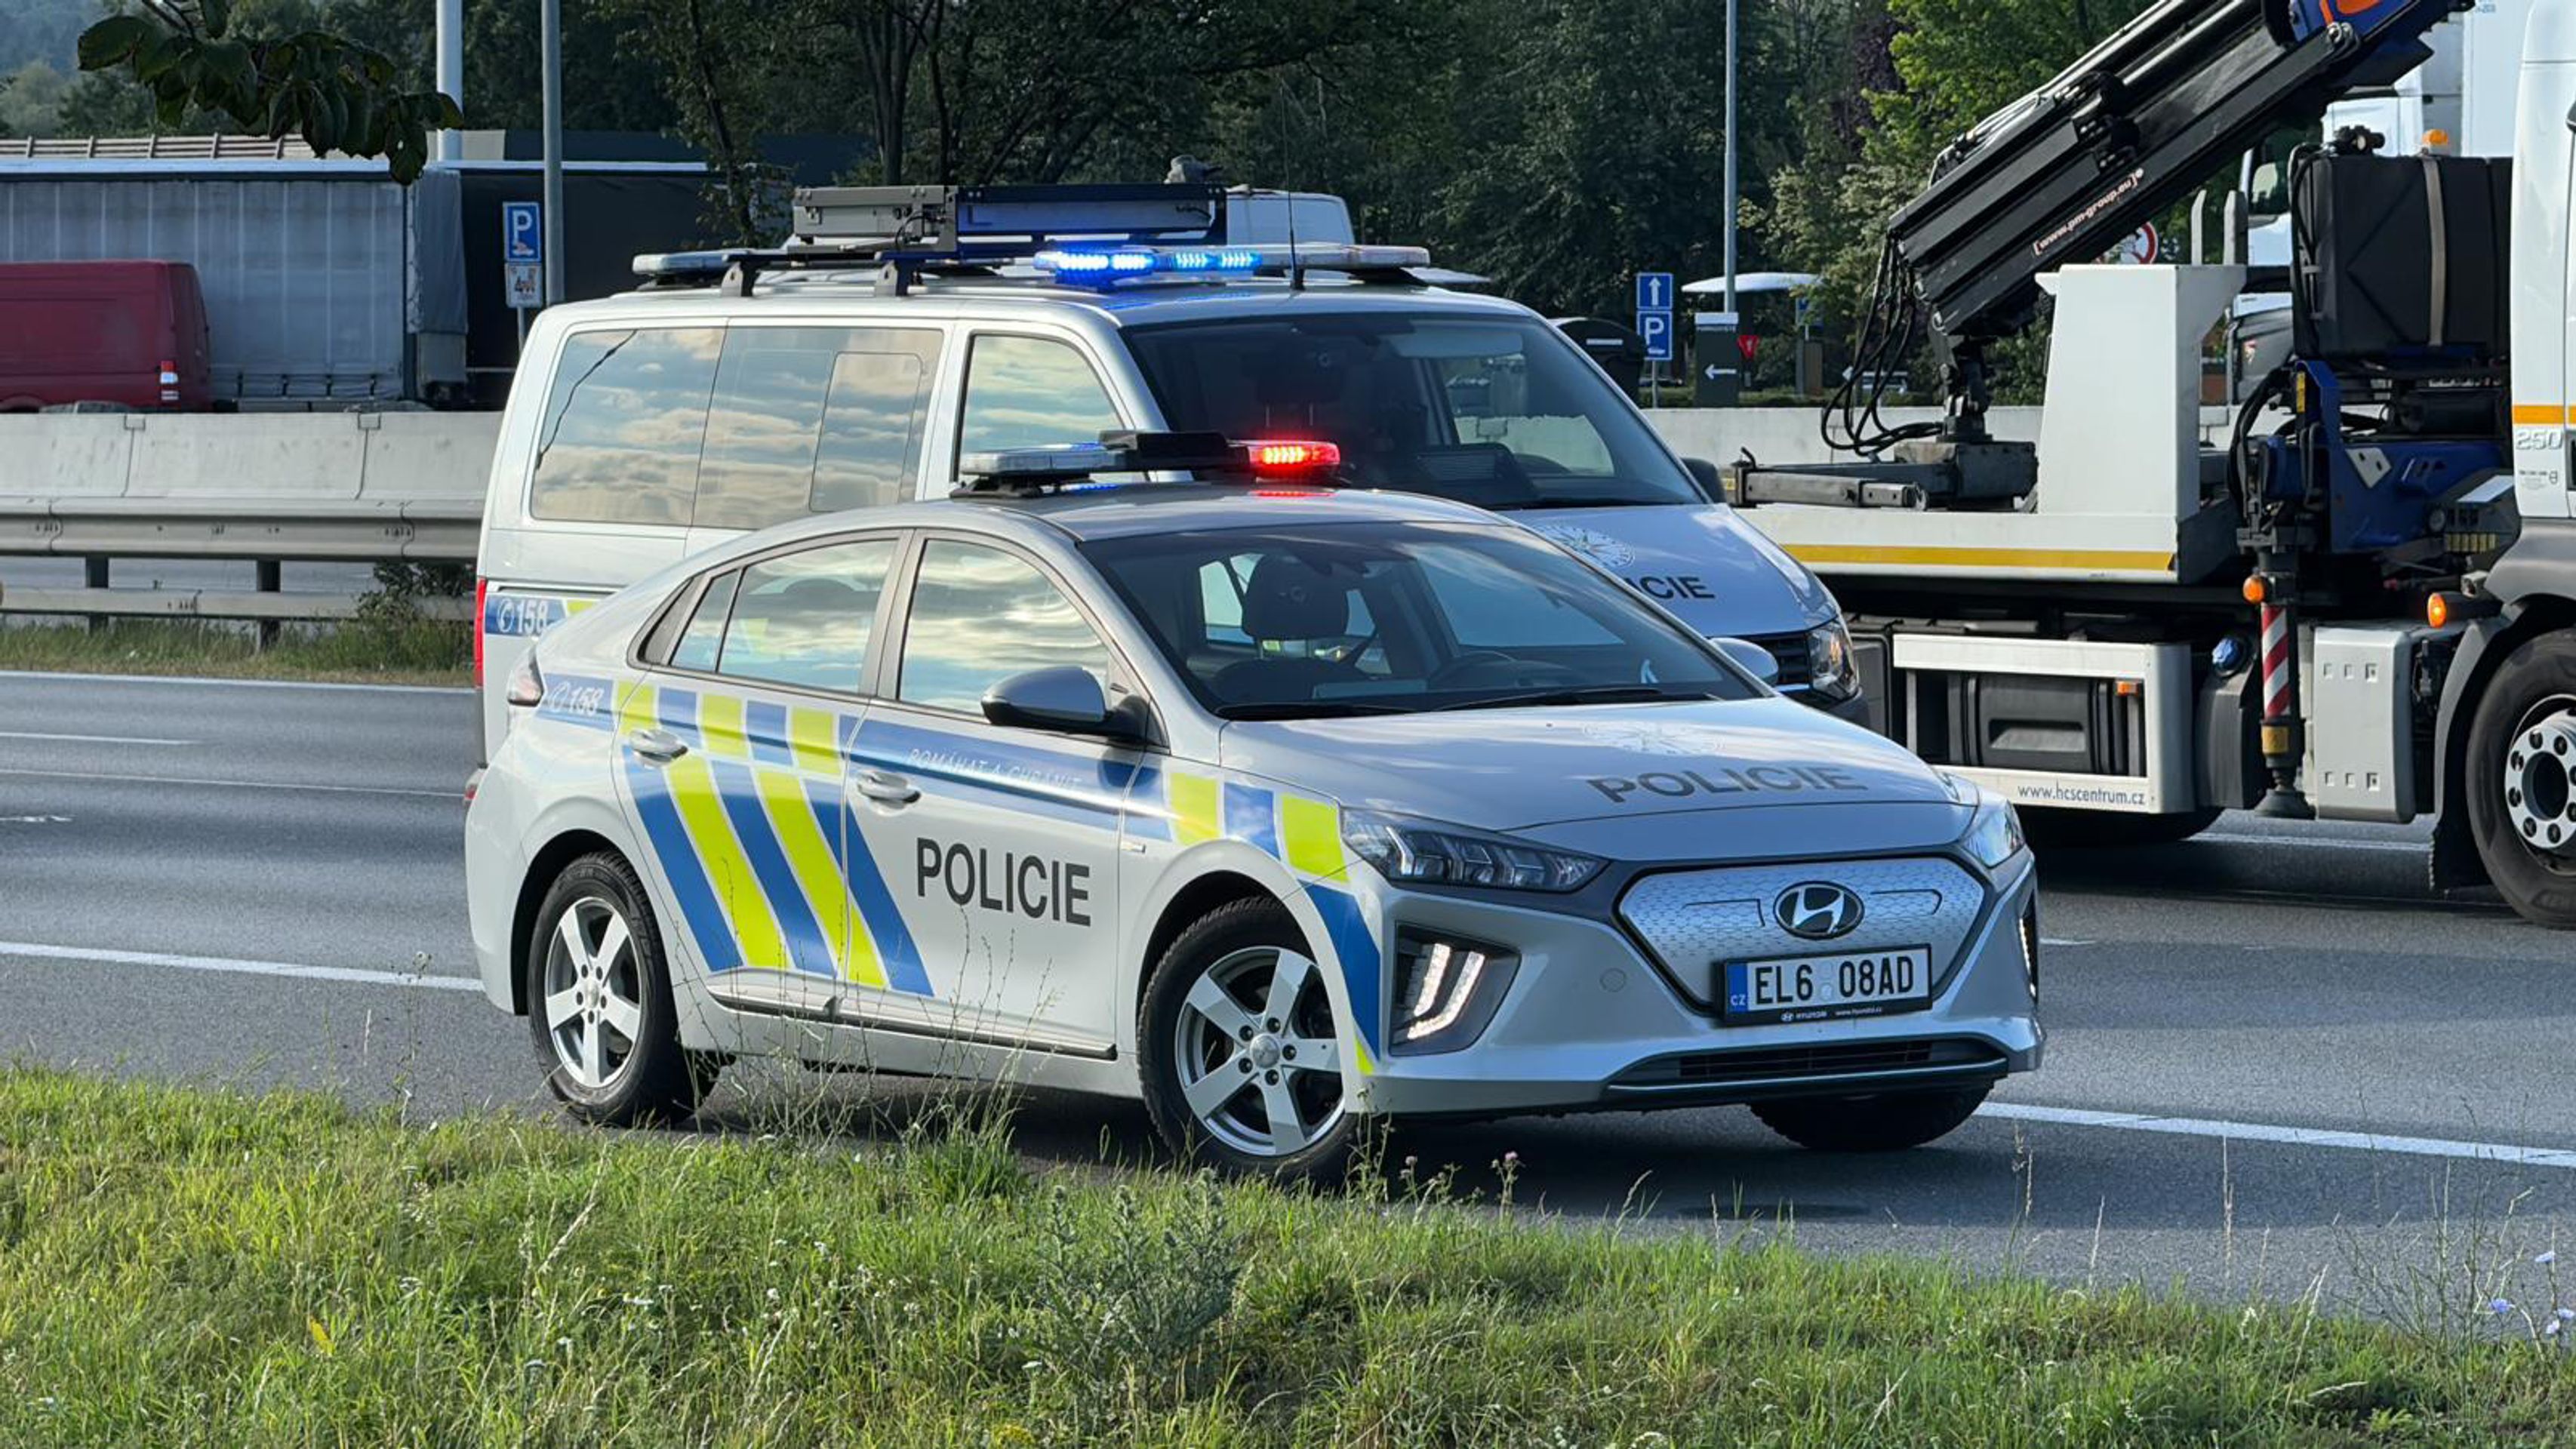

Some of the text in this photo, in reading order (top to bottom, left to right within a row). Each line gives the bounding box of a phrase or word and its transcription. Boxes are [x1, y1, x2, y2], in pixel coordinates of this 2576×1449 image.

[512, 210, 533, 247] P
[1645, 317, 1665, 346] P
[2516, 431, 2563, 451] 250
[1624, 576, 1715, 598] ICIE
[517, 599, 549, 635] 158
[568, 686, 605, 717] 158
[1587, 765, 1868, 804] POLICIE
[2017, 779, 2147, 806] www.hcscentrum.cz
[917, 837, 1091, 927] POLICIE
[1756, 956, 1914, 1004] EL6 08AD
[1730, 995, 1747, 1006] CZ
